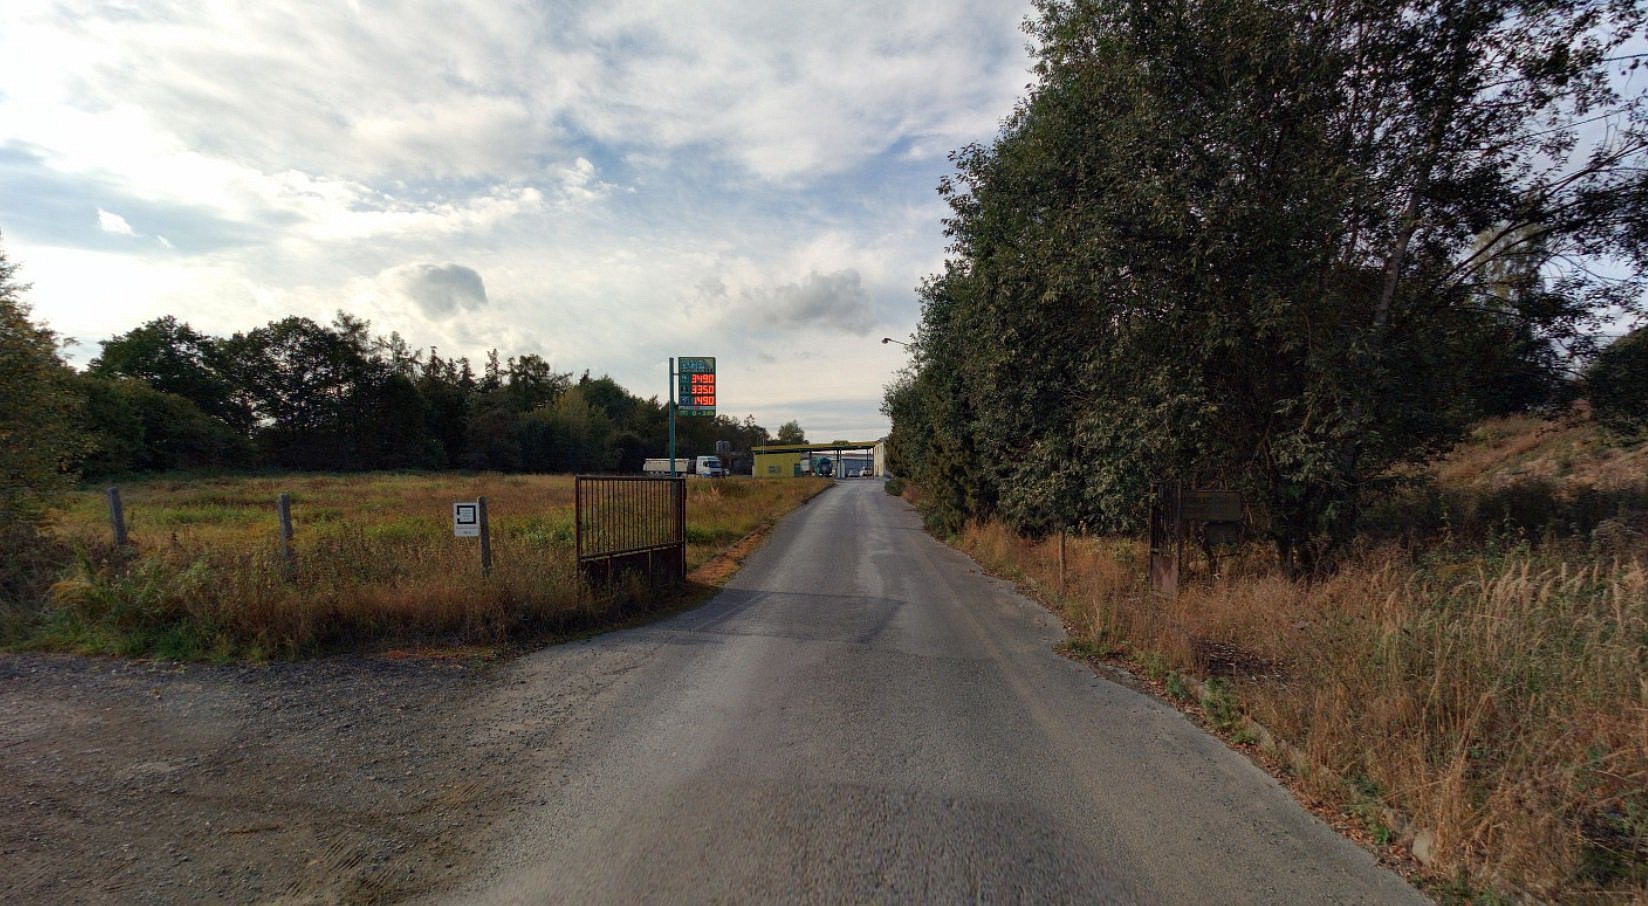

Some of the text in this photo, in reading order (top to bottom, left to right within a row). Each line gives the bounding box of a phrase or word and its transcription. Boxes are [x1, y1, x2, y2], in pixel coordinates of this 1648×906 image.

[691, 374, 714, 383] 3490
[691, 385, 714, 394] 3350
[694, 396, 714, 405] 1490
